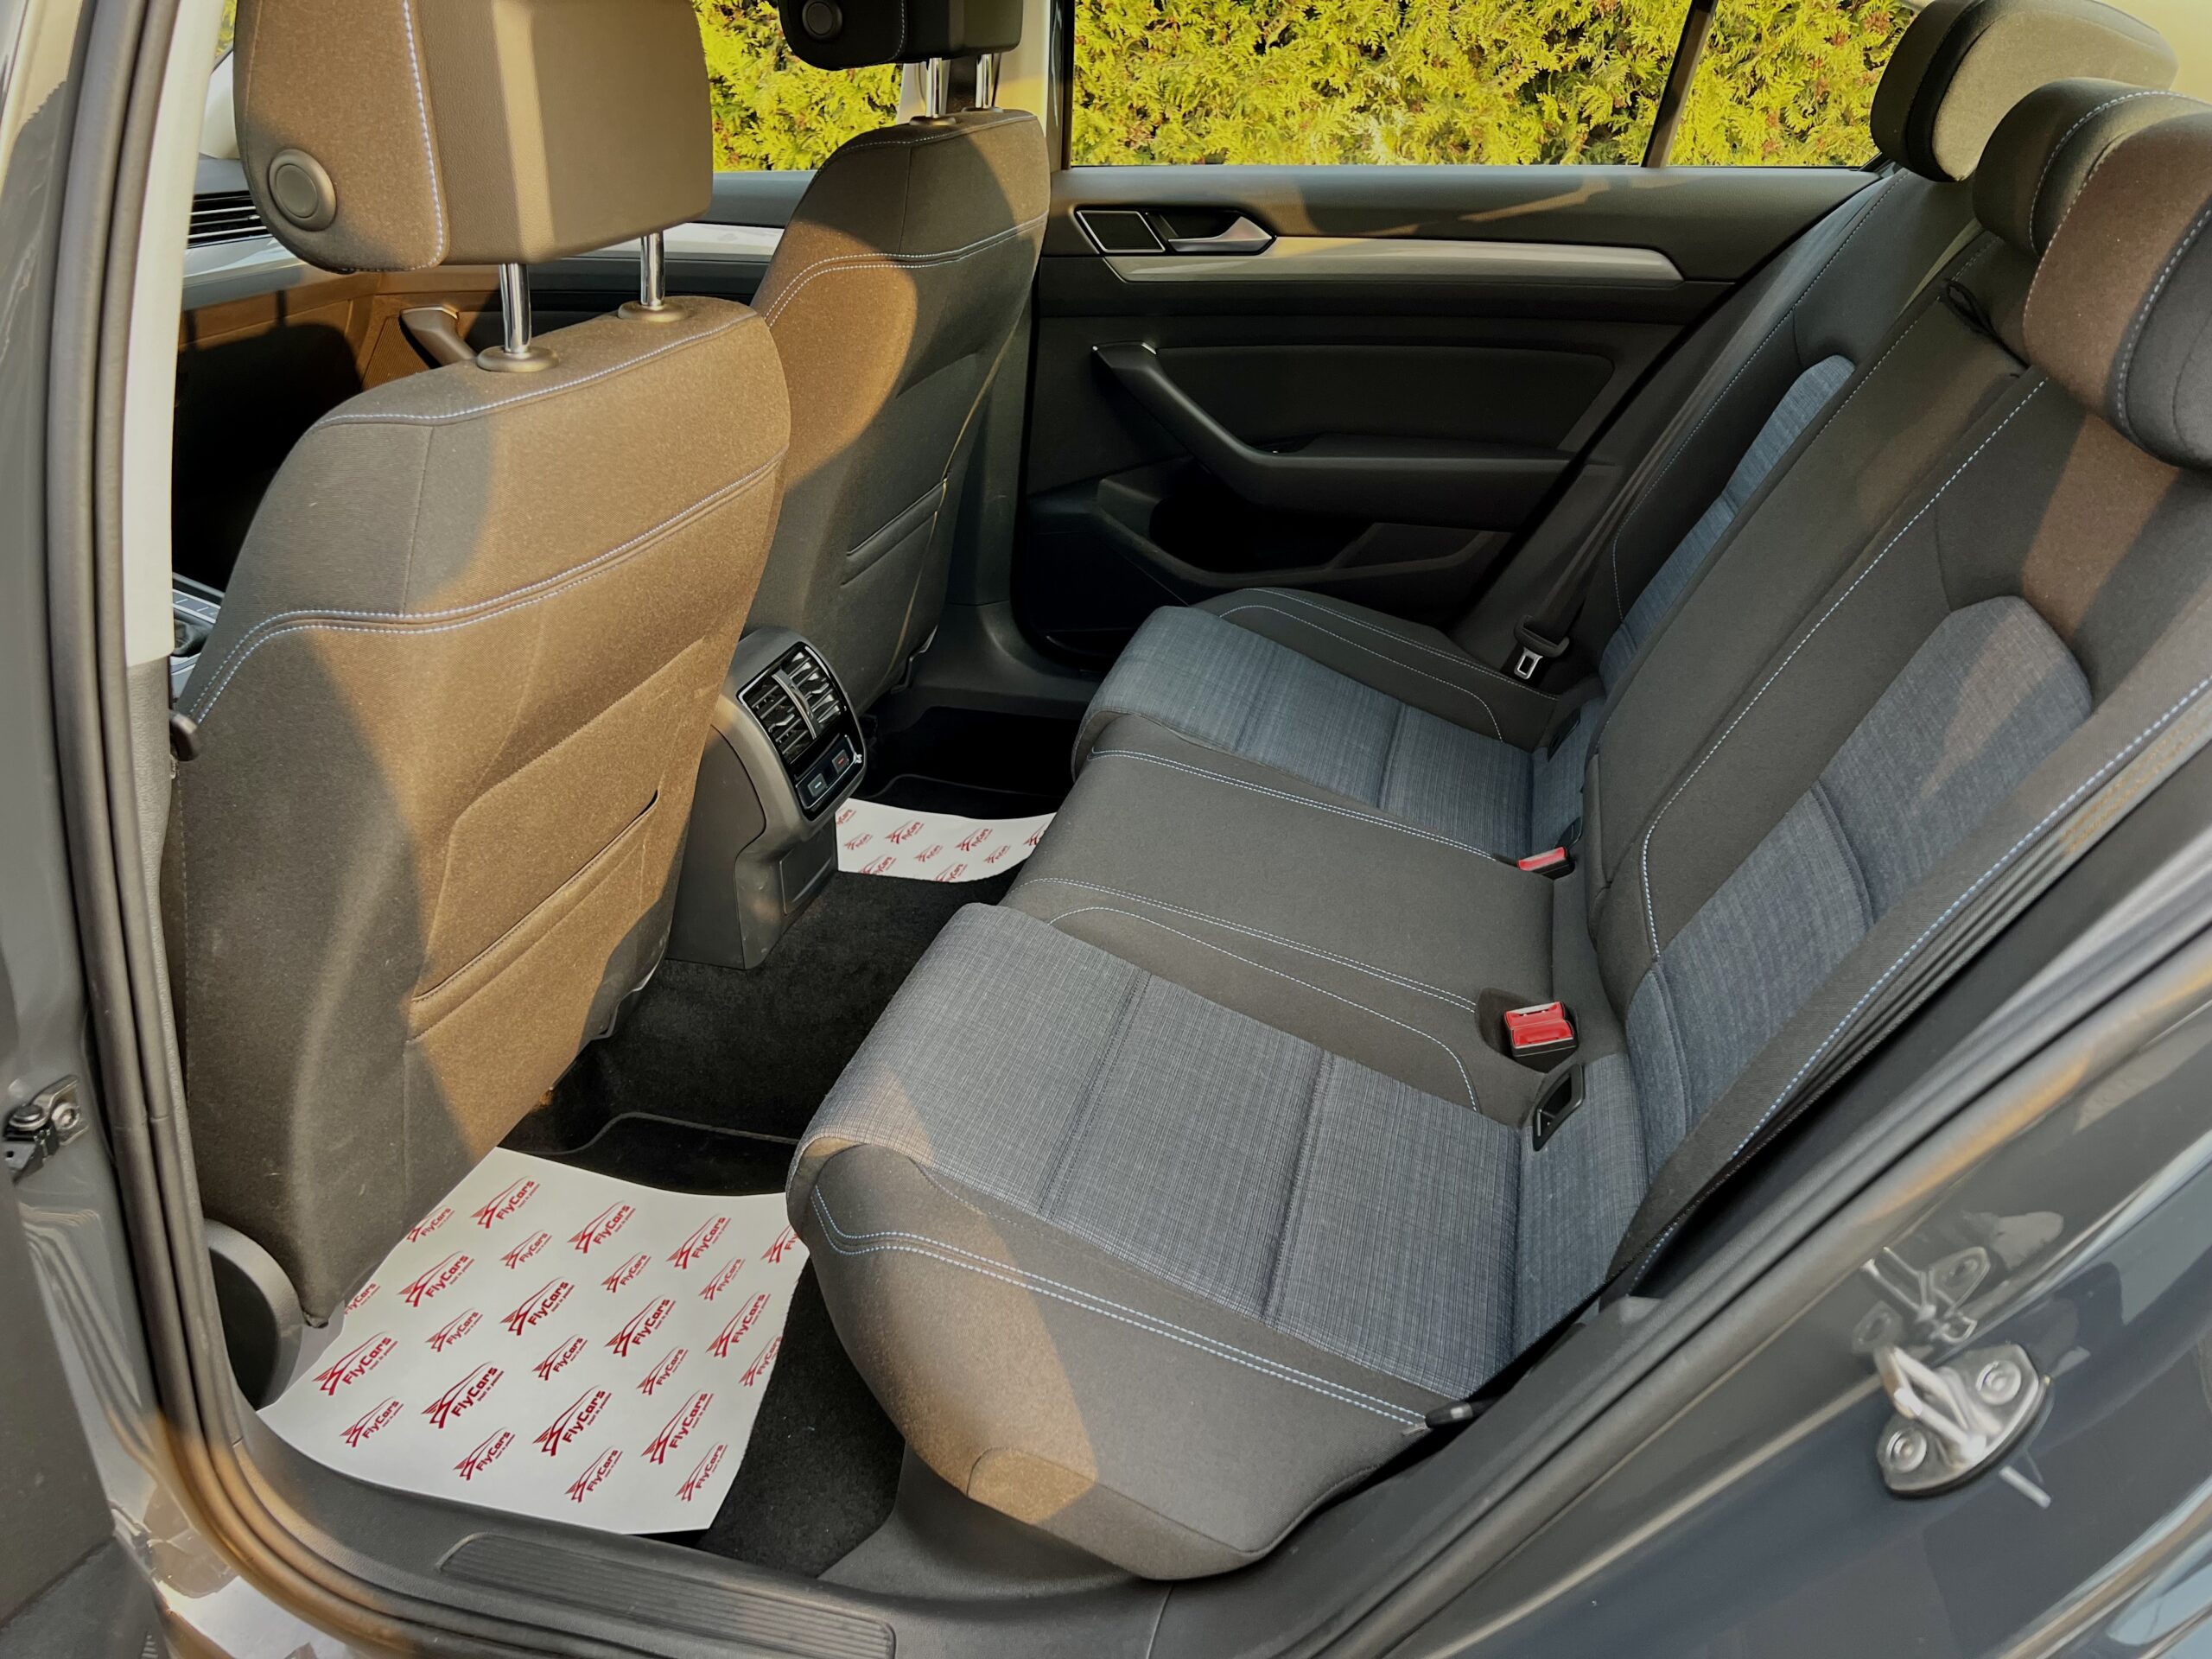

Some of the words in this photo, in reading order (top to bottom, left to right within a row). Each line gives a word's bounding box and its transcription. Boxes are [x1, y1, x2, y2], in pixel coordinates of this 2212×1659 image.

[495, 1180, 535, 1220] FlyCars
[420, 1207, 451, 1236] FlyCars
[593, 1205, 631, 1244] FlyCars
[691, 1217, 727, 1258] FlyCars
[518, 1232, 548, 1263] FlyCars
[425, 1255, 468, 1298] FlyCars
[620, 1254, 647, 1286] FlyCars
[528, 1281, 569, 1325] FlyCars
[632, 1299, 670, 1345] FlyCars
[731, 1294, 766, 1344] FlyCars
[446, 1311, 479, 1345] FlyCars
[341, 1337, 392, 1385] FlyCars
[552, 1338, 584, 1372] FlyCars
[656, 1349, 684, 1385] FlyCars
[450, 1367, 498, 1417] FlyCars
[361, 1401, 399, 1440] FlyCars
[562, 1390, 605, 1443] FlyCars
[669, 1393, 708, 1448] FlyCars
[476, 1432, 510, 1471] FlyCars
[587, 1450, 619, 1491] FlyCars
[695, 1445, 723, 1489] FlyCars
